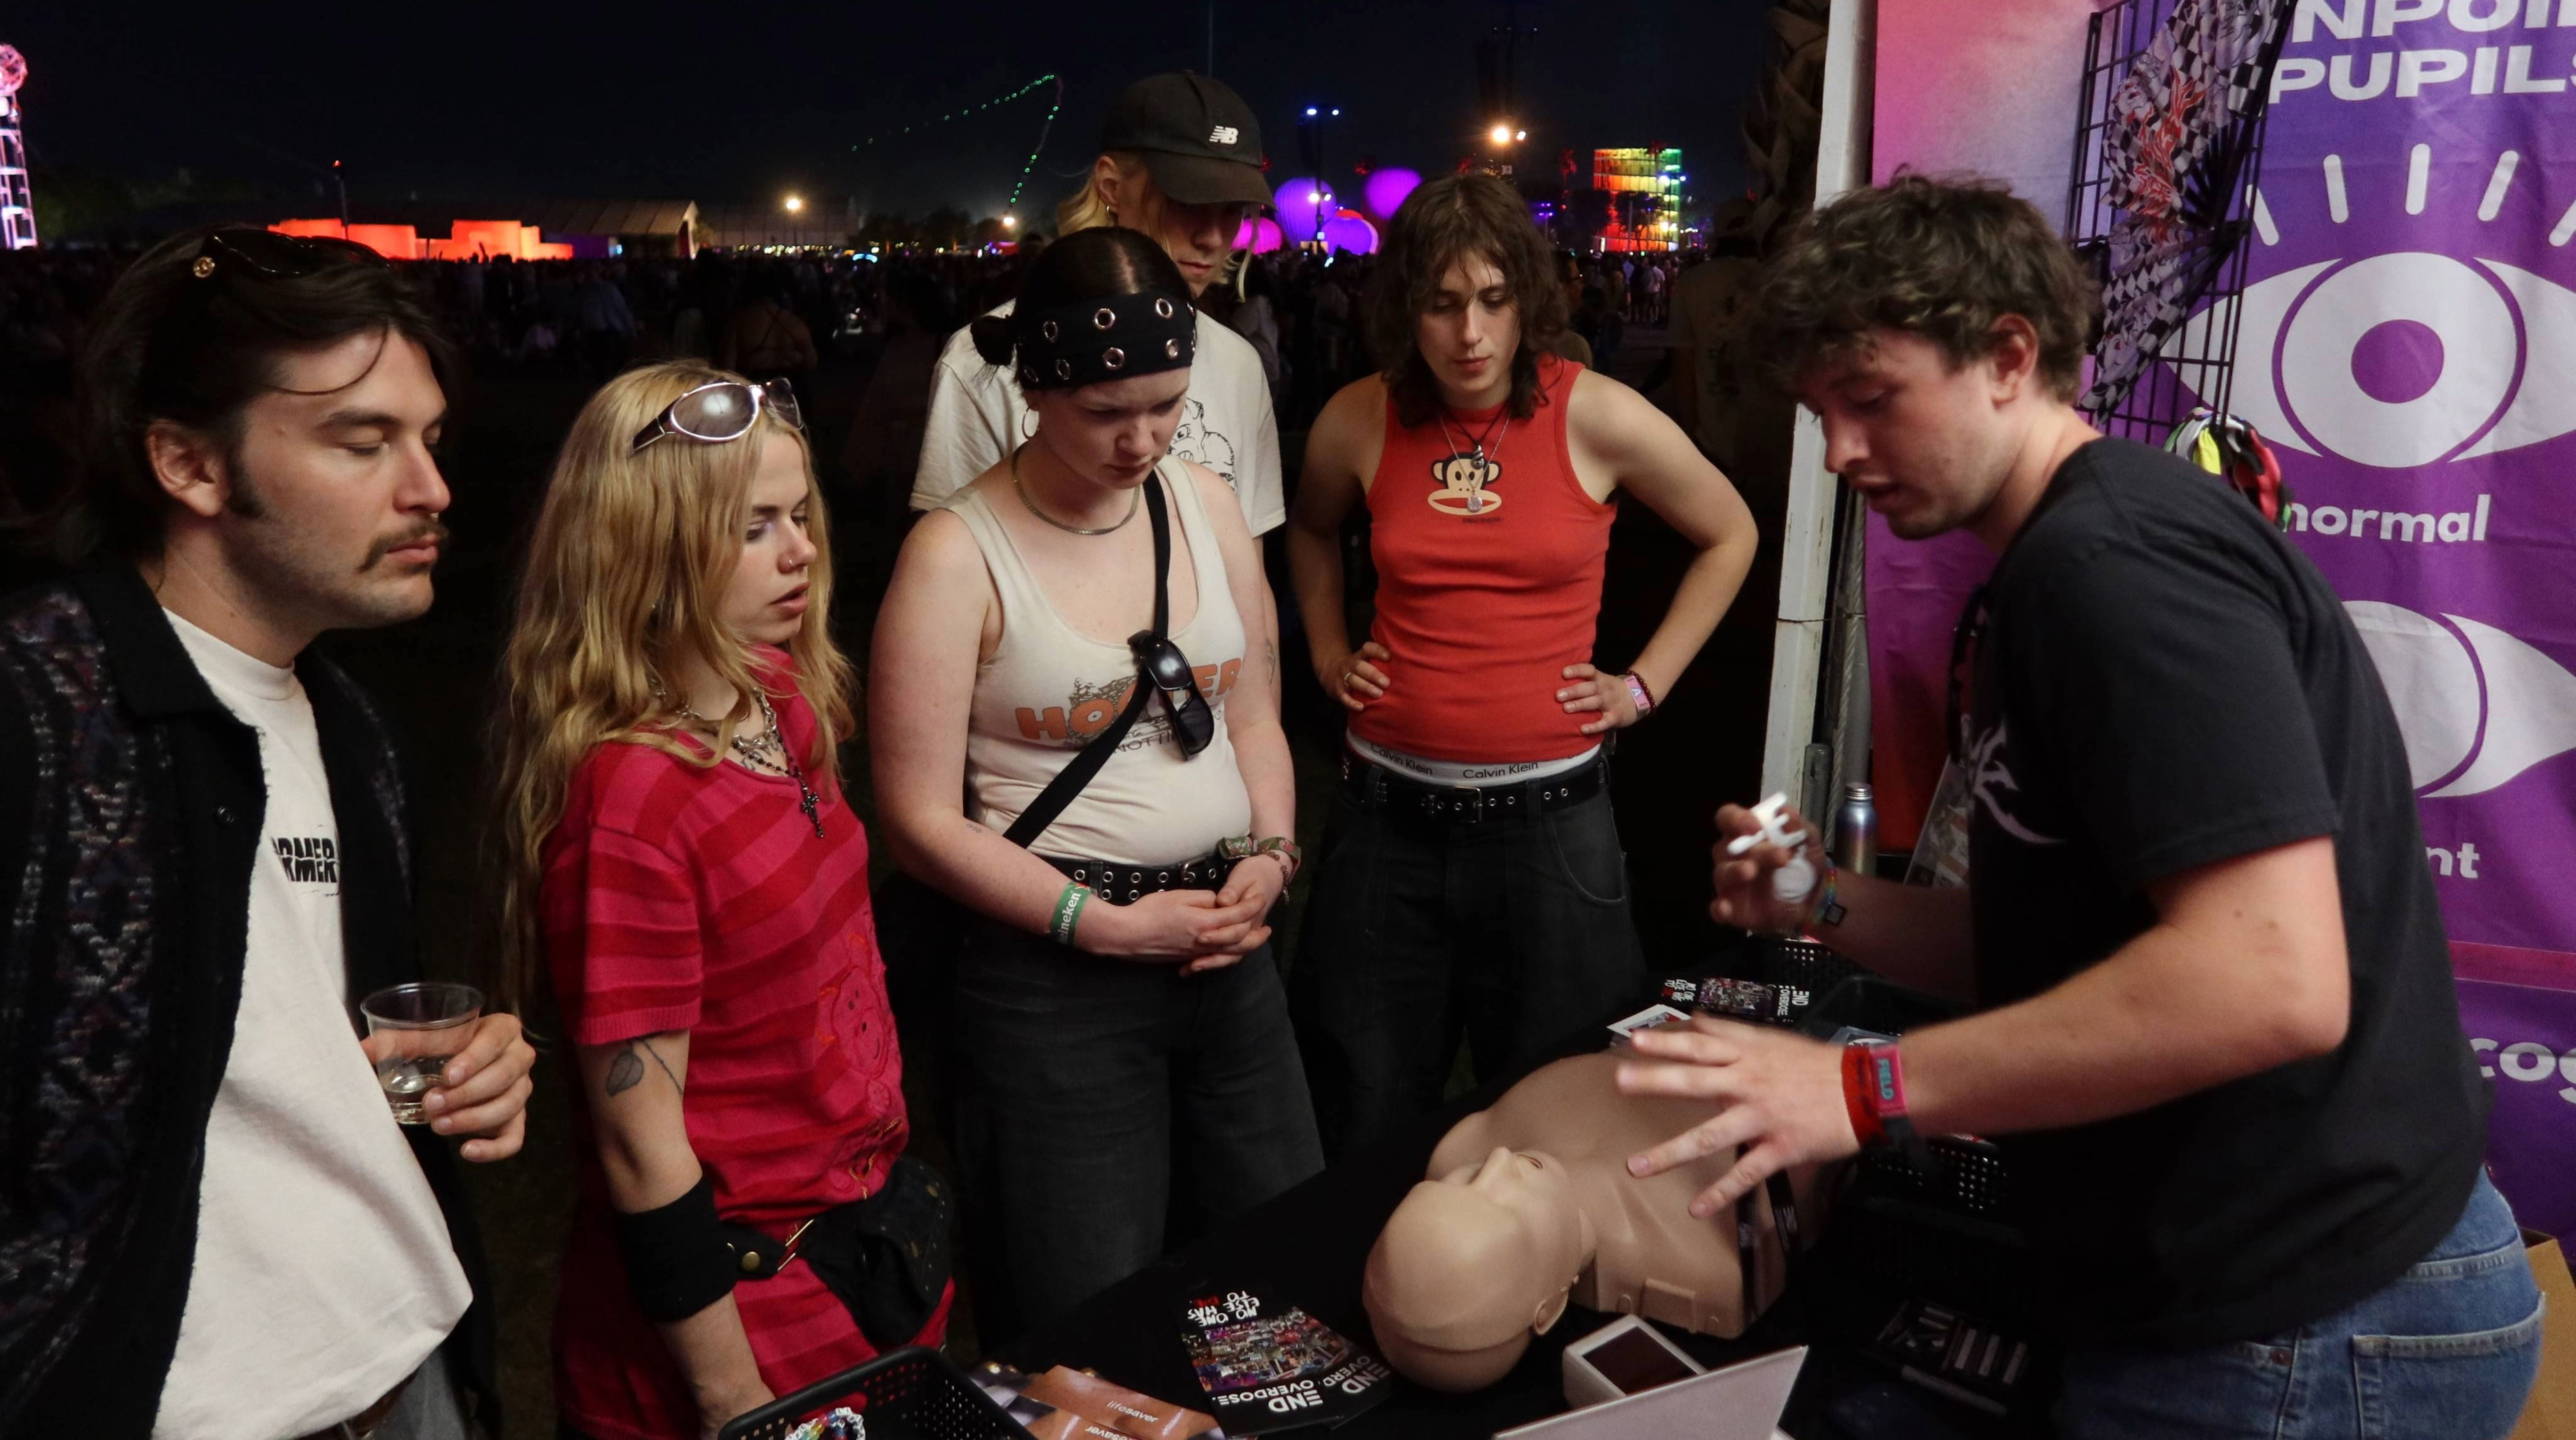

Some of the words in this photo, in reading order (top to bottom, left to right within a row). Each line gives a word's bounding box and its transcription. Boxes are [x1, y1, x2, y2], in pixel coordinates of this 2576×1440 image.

[2292, 0, 2576, 43] NPOI
[2268, 45, 2576, 104] PUPIL
[2290, 493, 2491, 543] normal
[1370, 744, 1403, 766] Calvin
[1406, 759, 1433, 776] Klein
[1463, 769, 1505, 779] Calvin
[1509, 761, 1538, 774] Klein
[271, 837, 338, 883] RMER
[2425, 842, 2480, 879] nt
[1058, 892, 1082, 945] eineken
[1792, 990, 1809, 1006] END
[1223, 1297, 1260, 1312] ELSE
[1227, 1290, 1250, 1302] TO
[1188, 1305, 1217, 1319] HAS
[1195, 1313, 1229, 1327] ONE
[1236, 1305, 1257, 1319] NO
[1318, 1356, 1370, 1386] OVERD
[1342, 1363, 1390, 1393] END
[1212, 1380, 1314, 1405] OVERDOSE.
[1268, 1390, 1323, 1412] END
[1107, 1400, 1159, 1422] lifesaver
[1085, 1426, 1132, 1440] esaver
